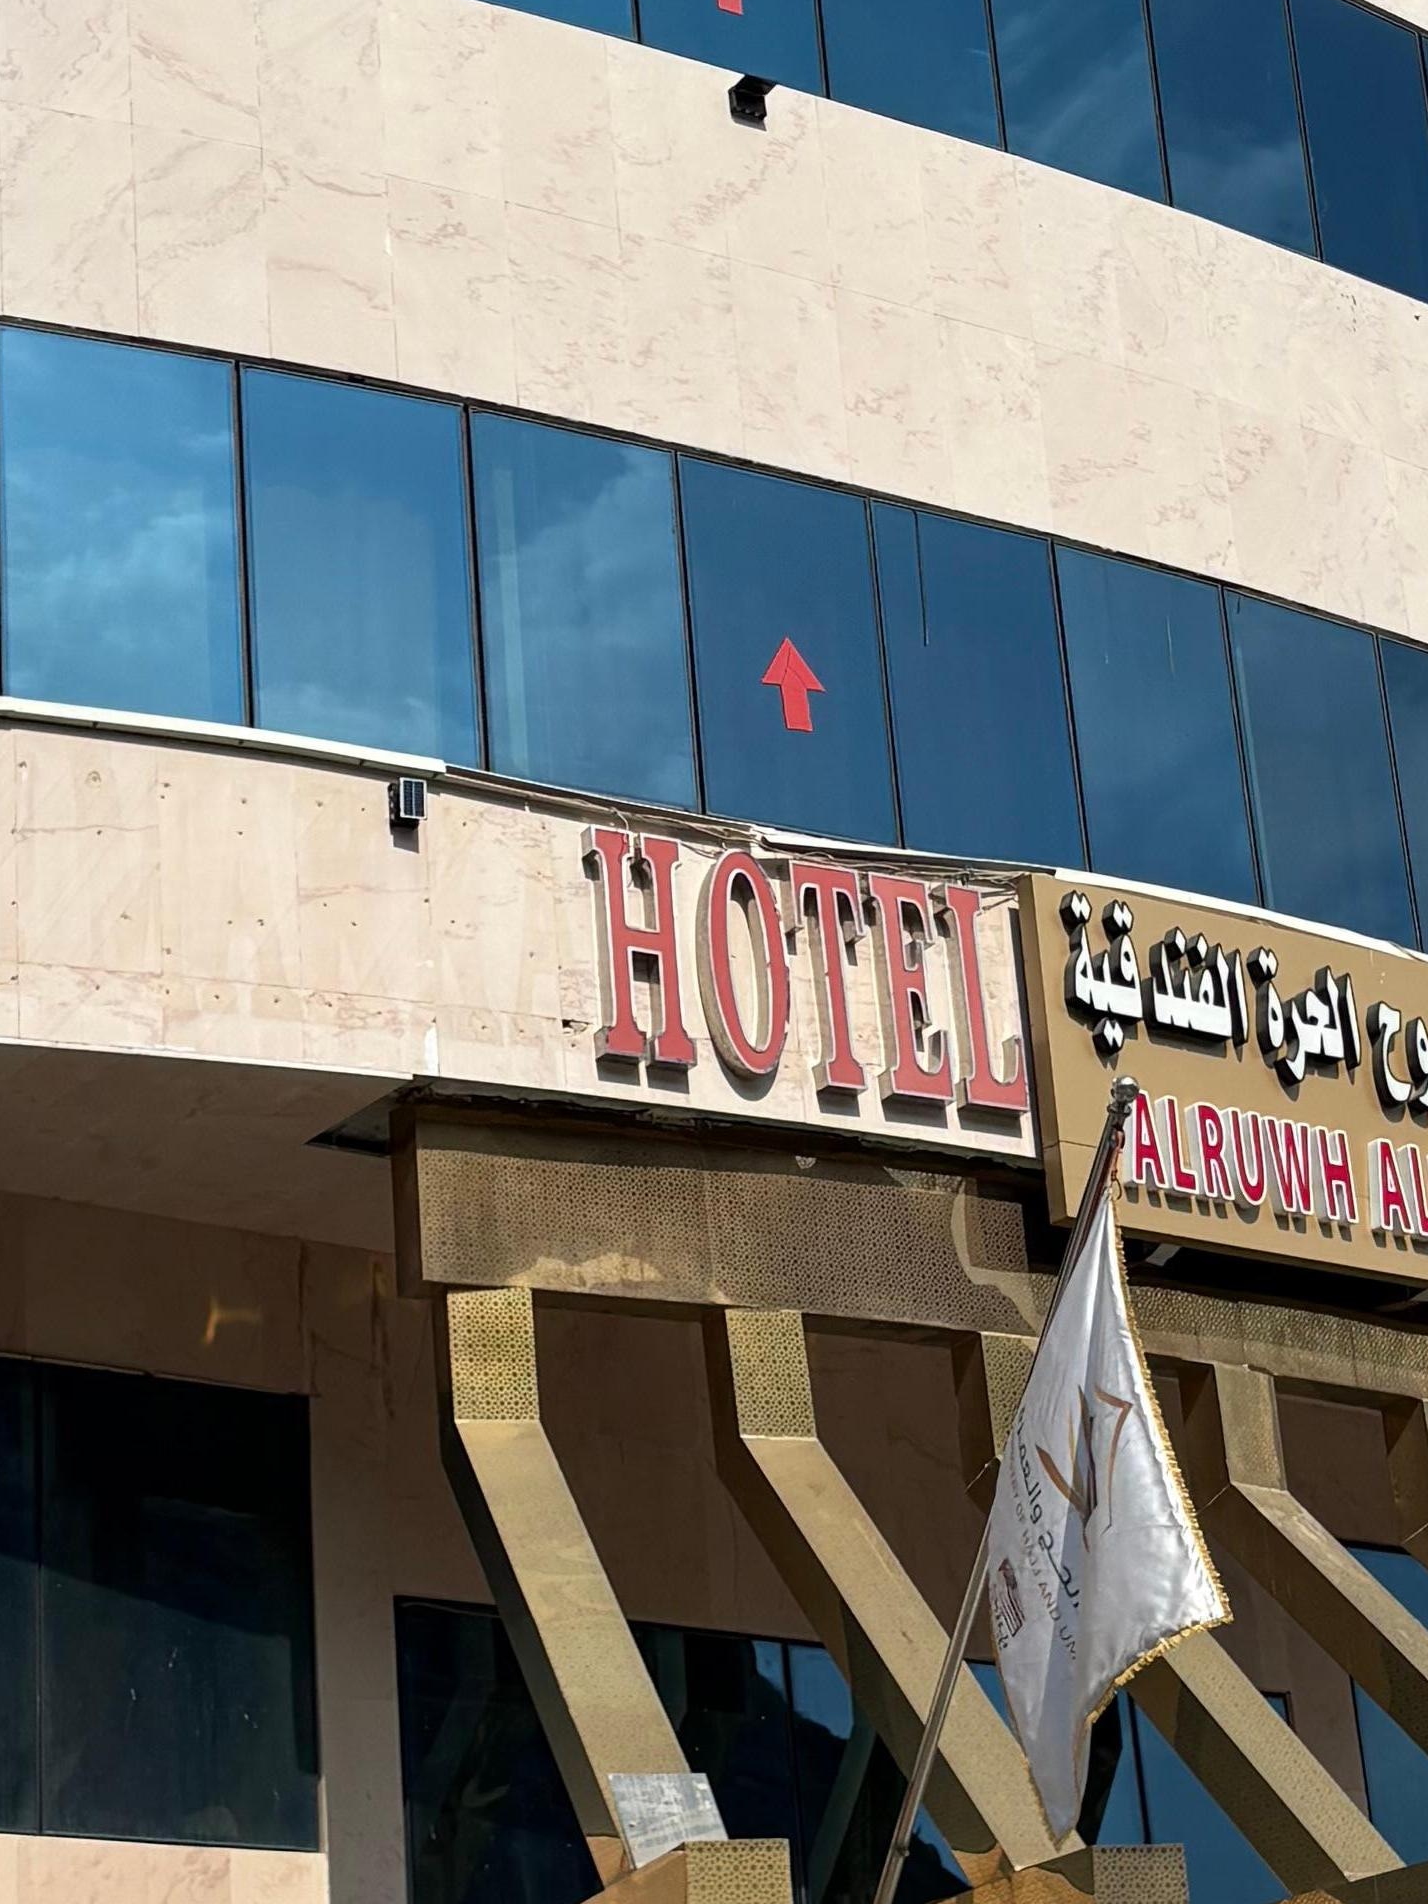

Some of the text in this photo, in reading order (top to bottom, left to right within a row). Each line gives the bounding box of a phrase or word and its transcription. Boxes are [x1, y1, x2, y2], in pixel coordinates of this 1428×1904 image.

[582, 825, 1030, 1114] HOTEL
[1061, 890, 1250, 1054] الفندقية
[1248, 947, 1362, 1086] الحرة
[1128, 1090, 1358, 1224] ALRUWH
